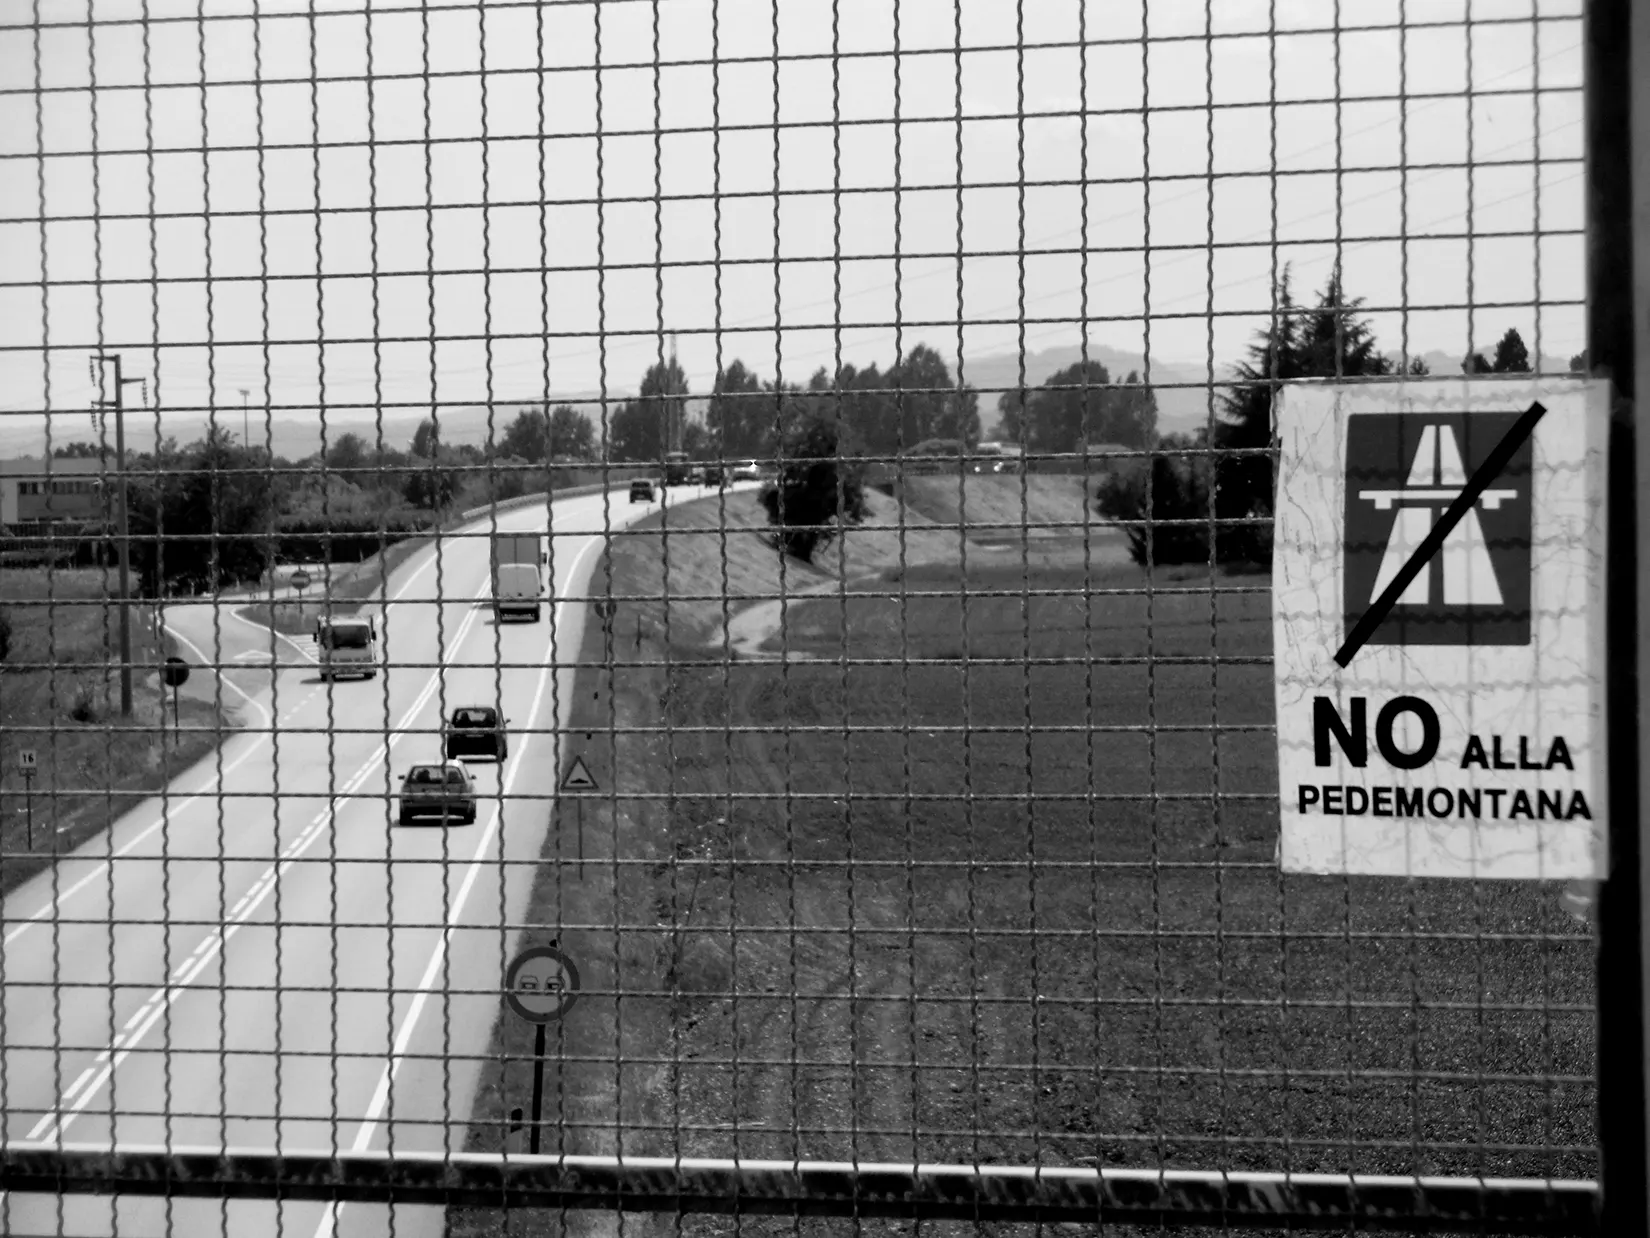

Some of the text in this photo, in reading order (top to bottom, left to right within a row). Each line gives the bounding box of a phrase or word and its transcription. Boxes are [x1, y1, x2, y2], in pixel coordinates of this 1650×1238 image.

[1313, 695, 1574, 770] NO ALLA
[1298, 784, 1592, 820] PEDEMONTANA
